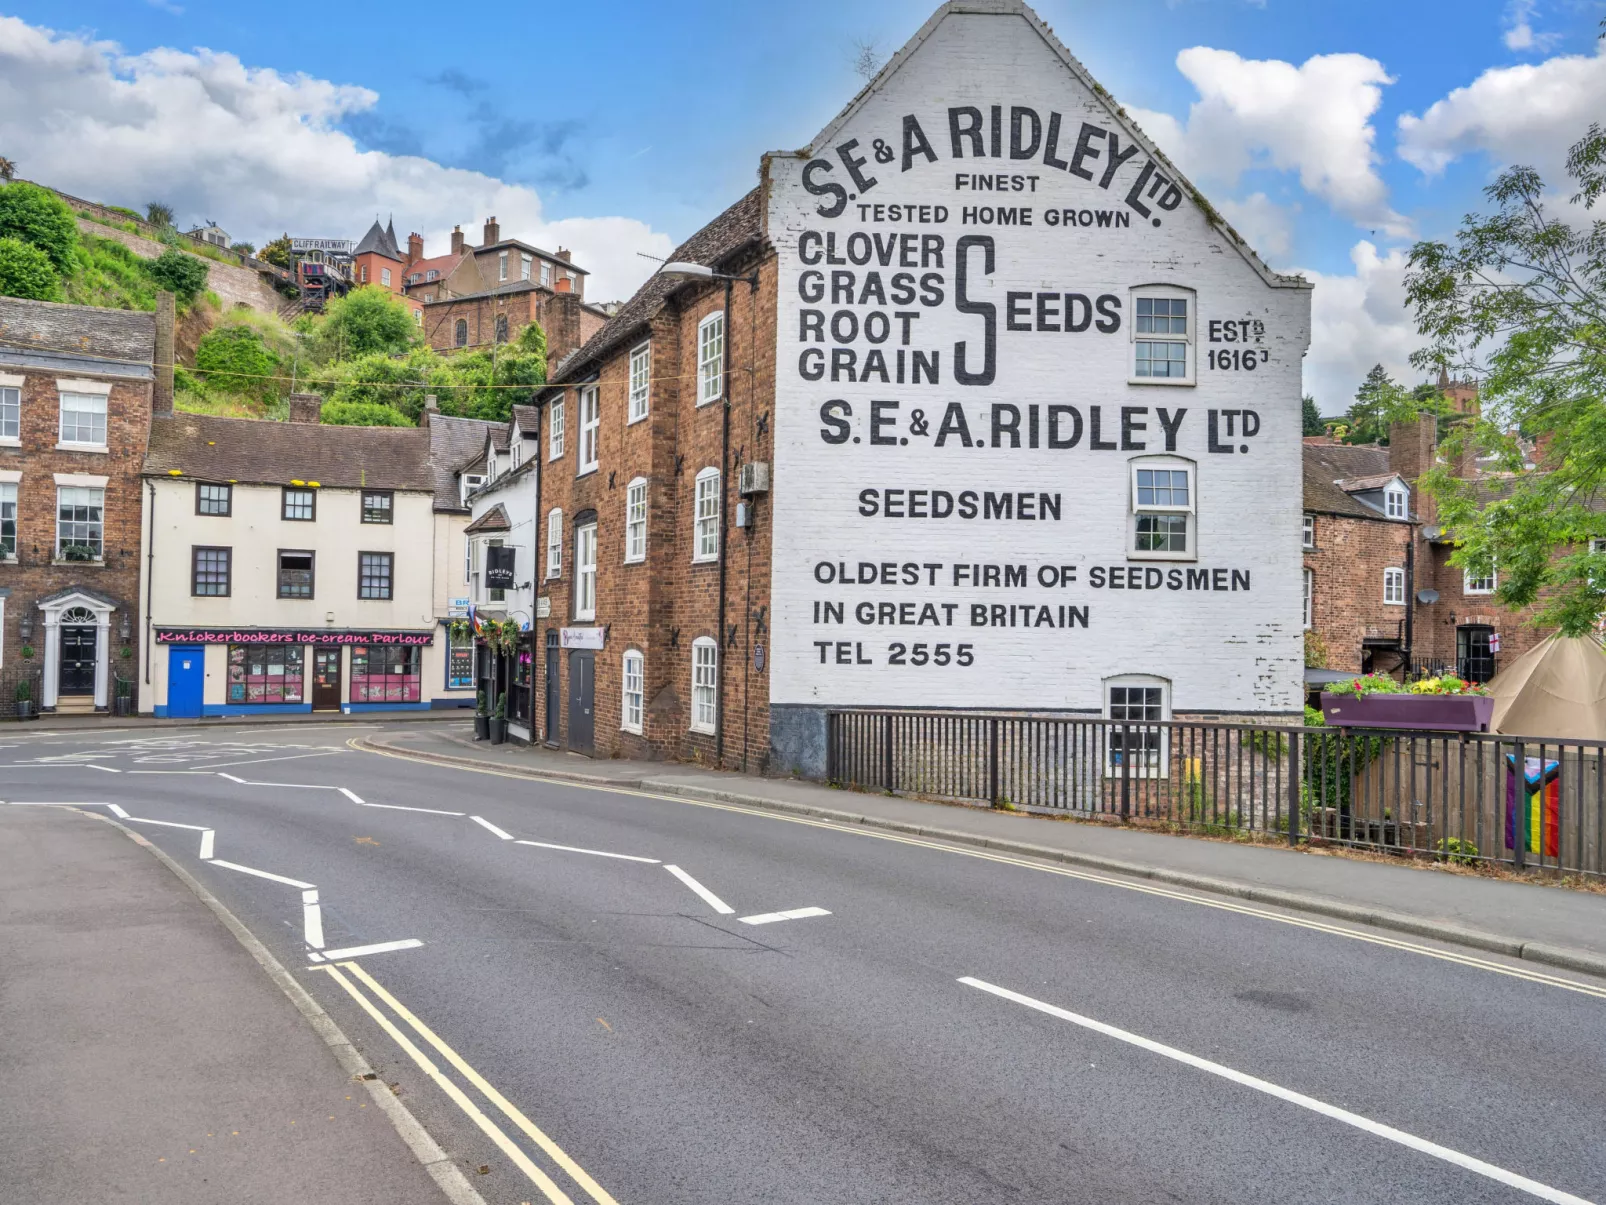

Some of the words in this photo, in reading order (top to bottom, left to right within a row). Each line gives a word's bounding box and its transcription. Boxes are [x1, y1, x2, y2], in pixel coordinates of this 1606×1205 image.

[901, 113, 939, 173] A
[948, 104, 1139, 190] RIDLEY
[956, 173, 1040, 192] FINEST
[856, 204, 949, 223] TESTED
[962, 206, 1033, 226] HOME
[1044, 208, 1130, 228] GROWN
[293, 240, 313, 249] CLIFF
[314, 240, 346, 250] RAILWAY
[799, 231, 945, 268] CLOVER
[798, 270, 945, 307] GRASS
[799, 309, 920, 346] ROOT
[798, 348, 940, 385] GRAIN
[858, 488, 1061, 521] SEEDSMEN
[814, 561, 943, 586] OLDEST
[953, 563, 1027, 588] FIRM
[1037, 565, 1077, 588] OF
[1089, 566, 1250, 591] SEEDSMEN
[813, 601, 844, 624] IN
[855, 602, 959, 626] GREAT
[970, 604, 1089, 628] BRITAIN
[160, 630, 294, 643] Knickerbockers
[296, 633, 370, 643] Ice-cream
[372, 632, 430, 644] Parlour
[813, 641, 873, 665] TEL
[888, 642, 974, 667] 2555
